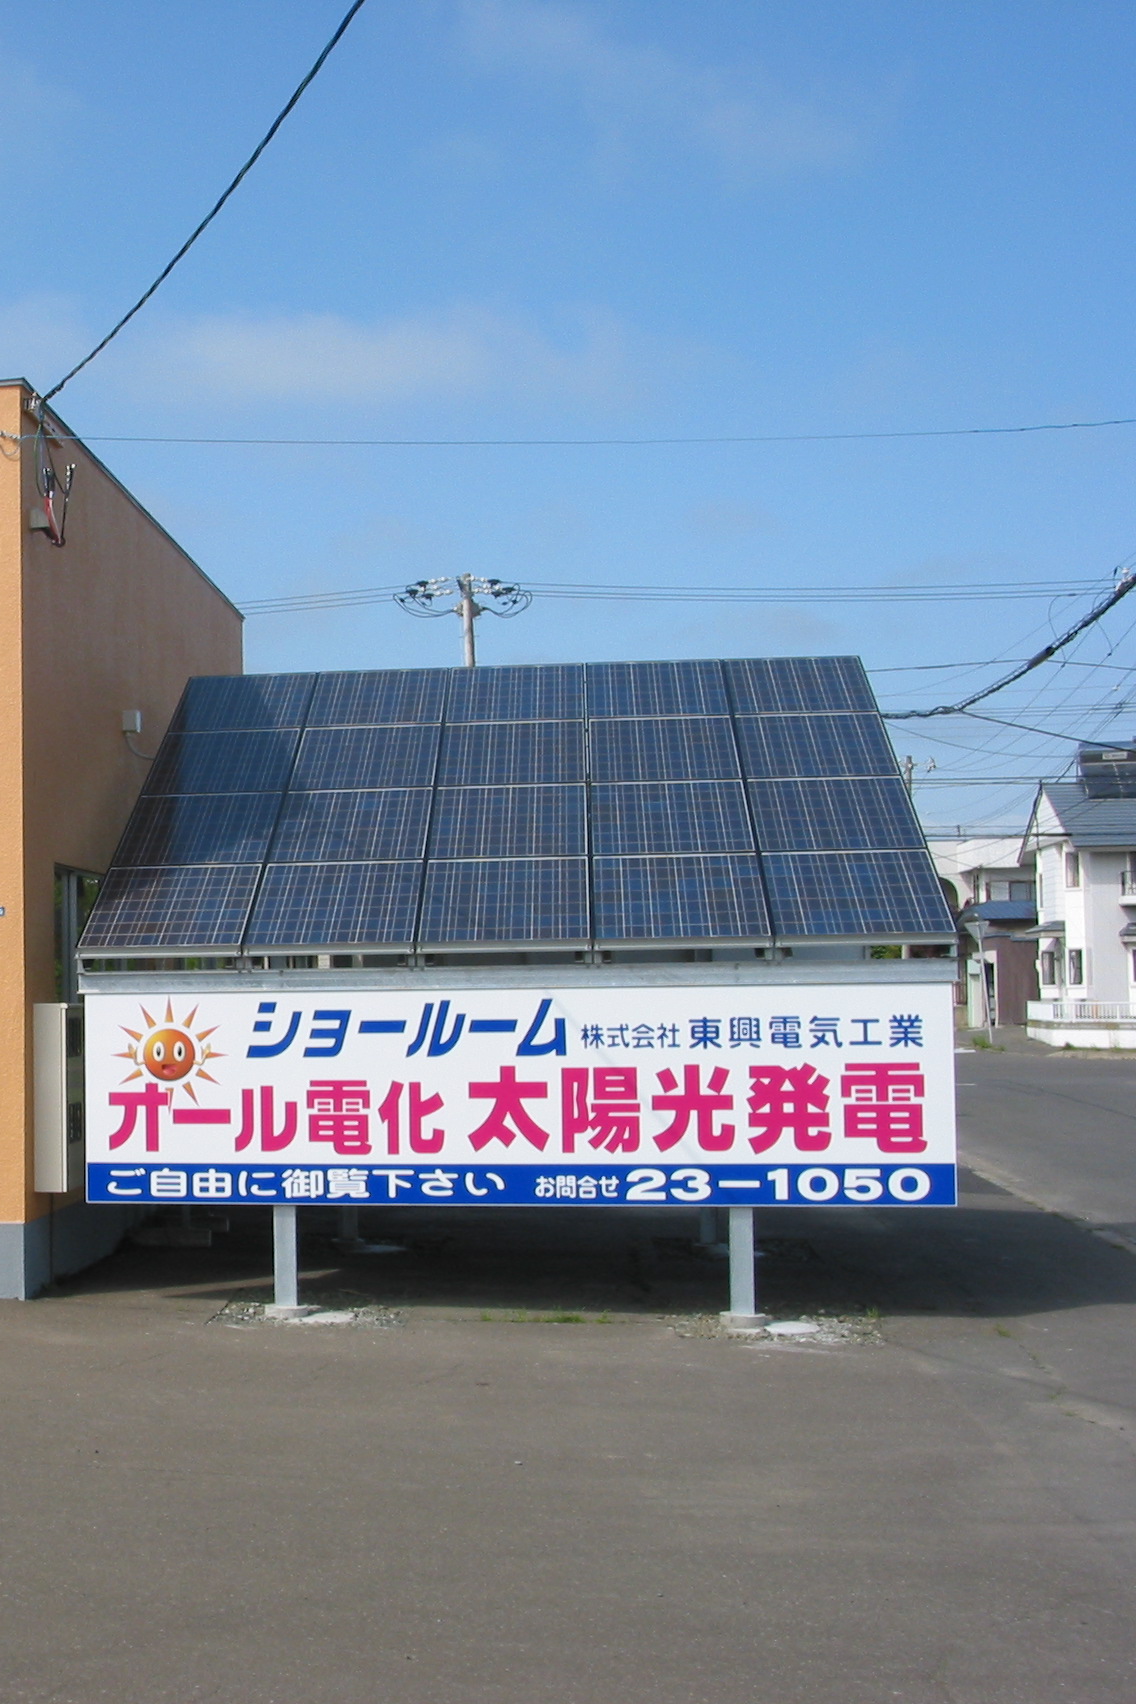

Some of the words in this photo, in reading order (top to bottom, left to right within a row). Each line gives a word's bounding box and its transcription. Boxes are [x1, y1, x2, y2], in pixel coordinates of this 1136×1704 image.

[246, 999, 567, 1059] ショールーム
[581, 1022, 681, 1049] 株式会社
[689, 1014, 924, 1049] 東興電気工業
[108, 1079, 446, 1156] オール電化
[467, 1062, 928, 1155] 太陽光発電
[107, 1167, 506, 1200] ご自由に御覧下さい
[534, 1174, 620, 1200] お問合せ
